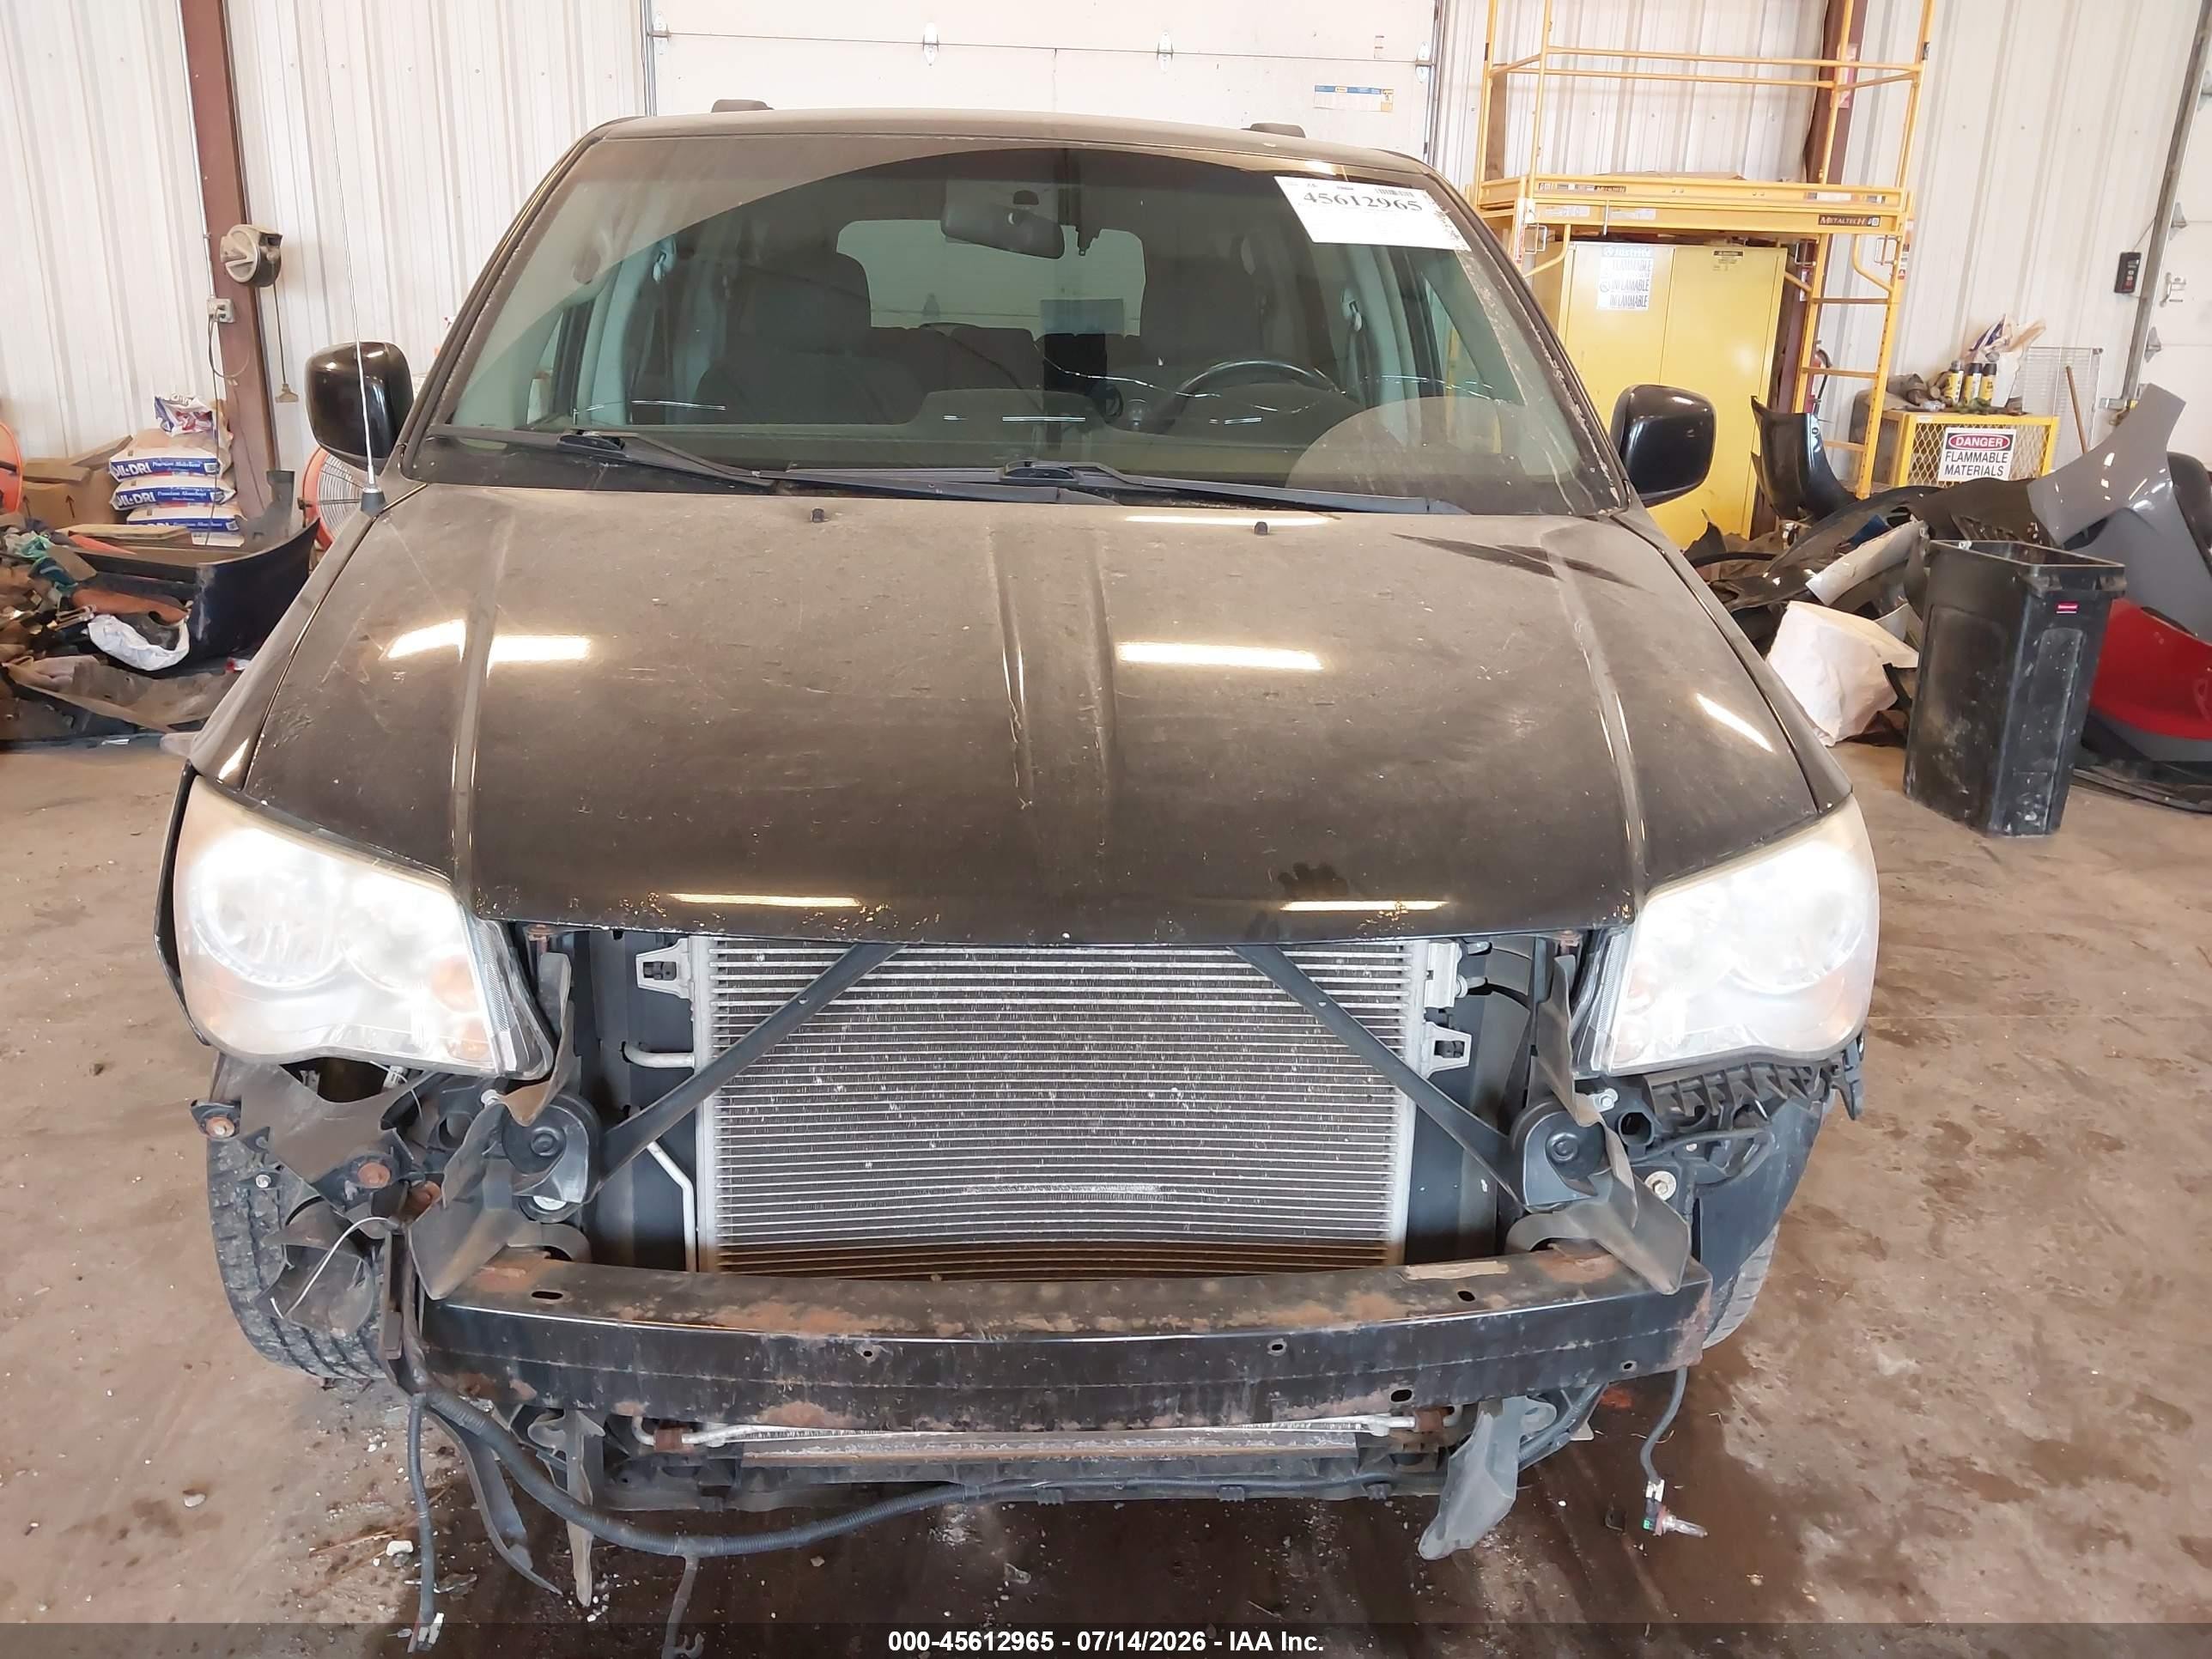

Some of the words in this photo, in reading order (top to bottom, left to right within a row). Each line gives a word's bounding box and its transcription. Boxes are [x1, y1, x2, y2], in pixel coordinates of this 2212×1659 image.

[1304, 191, 1423, 211] 45612965
[1955, 436, 2003, 447] DANGER
[1944, 451, 2008, 464] FLAMMABLE
[1944, 465, 2004, 477] MATERIALS
